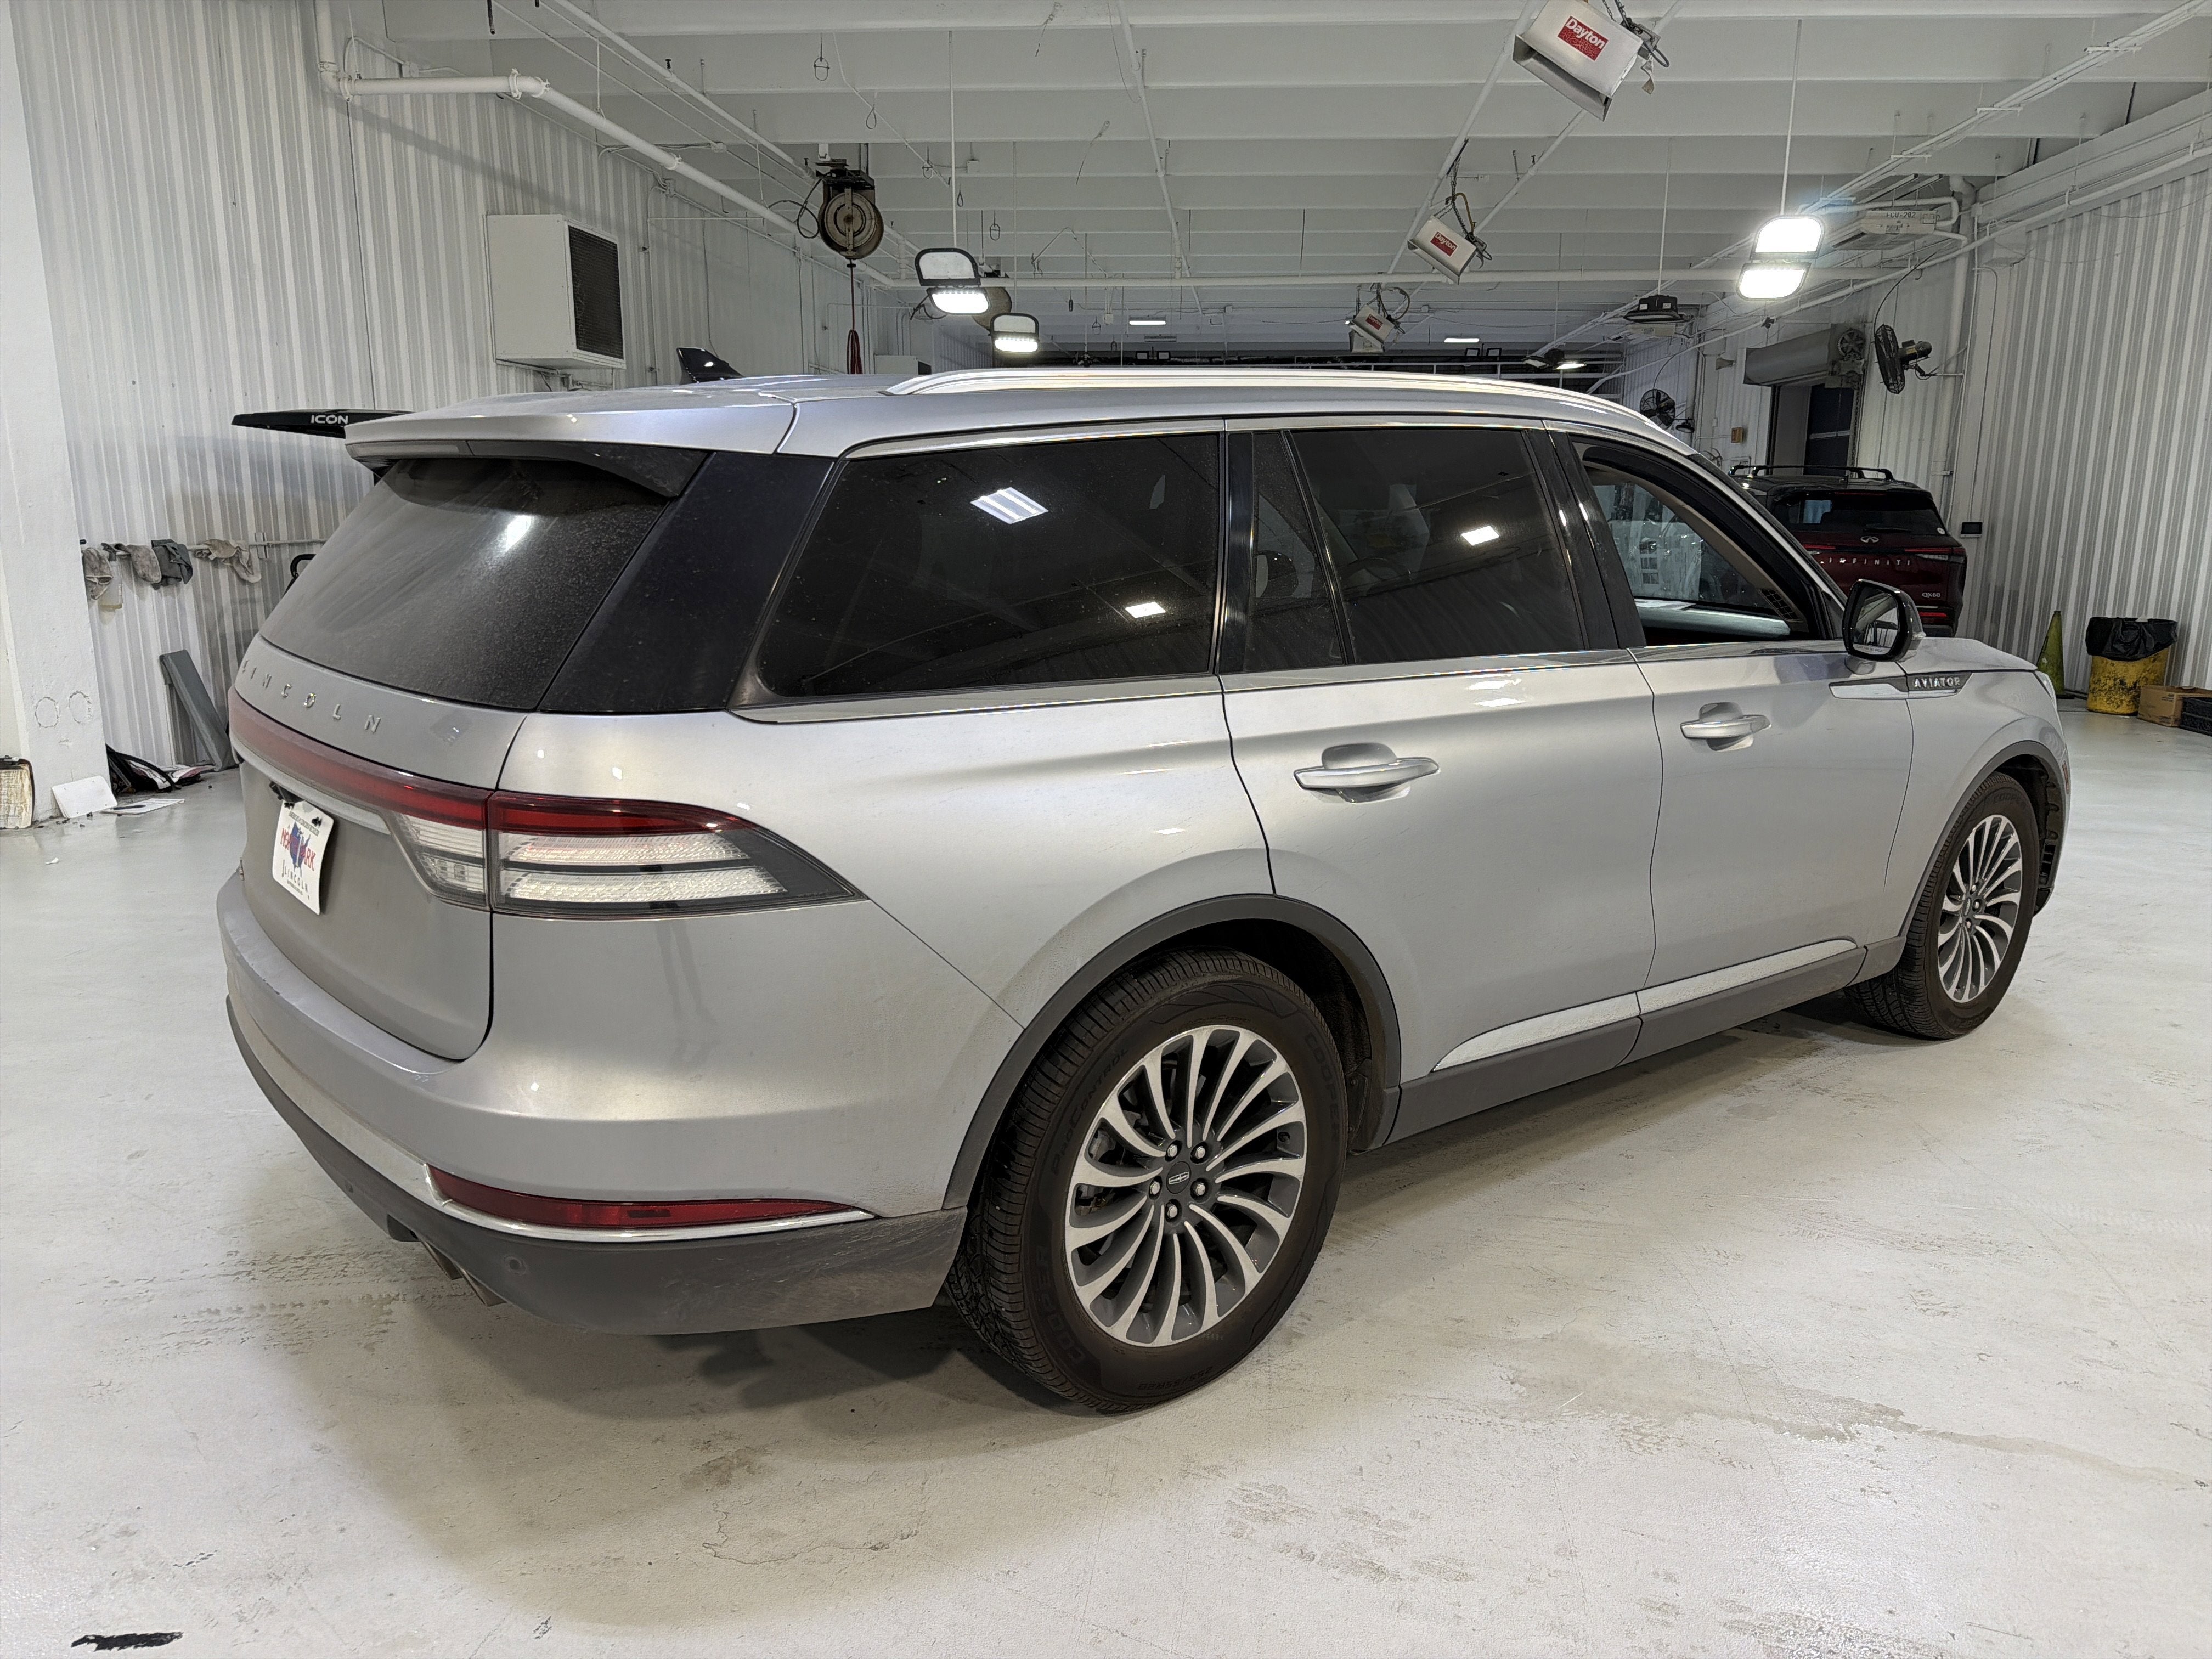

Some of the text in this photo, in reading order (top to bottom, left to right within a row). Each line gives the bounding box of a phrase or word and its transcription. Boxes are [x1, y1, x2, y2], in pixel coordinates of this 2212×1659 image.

[1565, 18, 1605, 49] Dayton
[1435, 233, 1456, 250] Dayton
[311, 414, 348, 425] ICON
[1829, 557, 1910, 566] INFINITI
[1914, 676, 1961, 689] AVIATOR
[241, 659, 382, 733] LINCOLN
